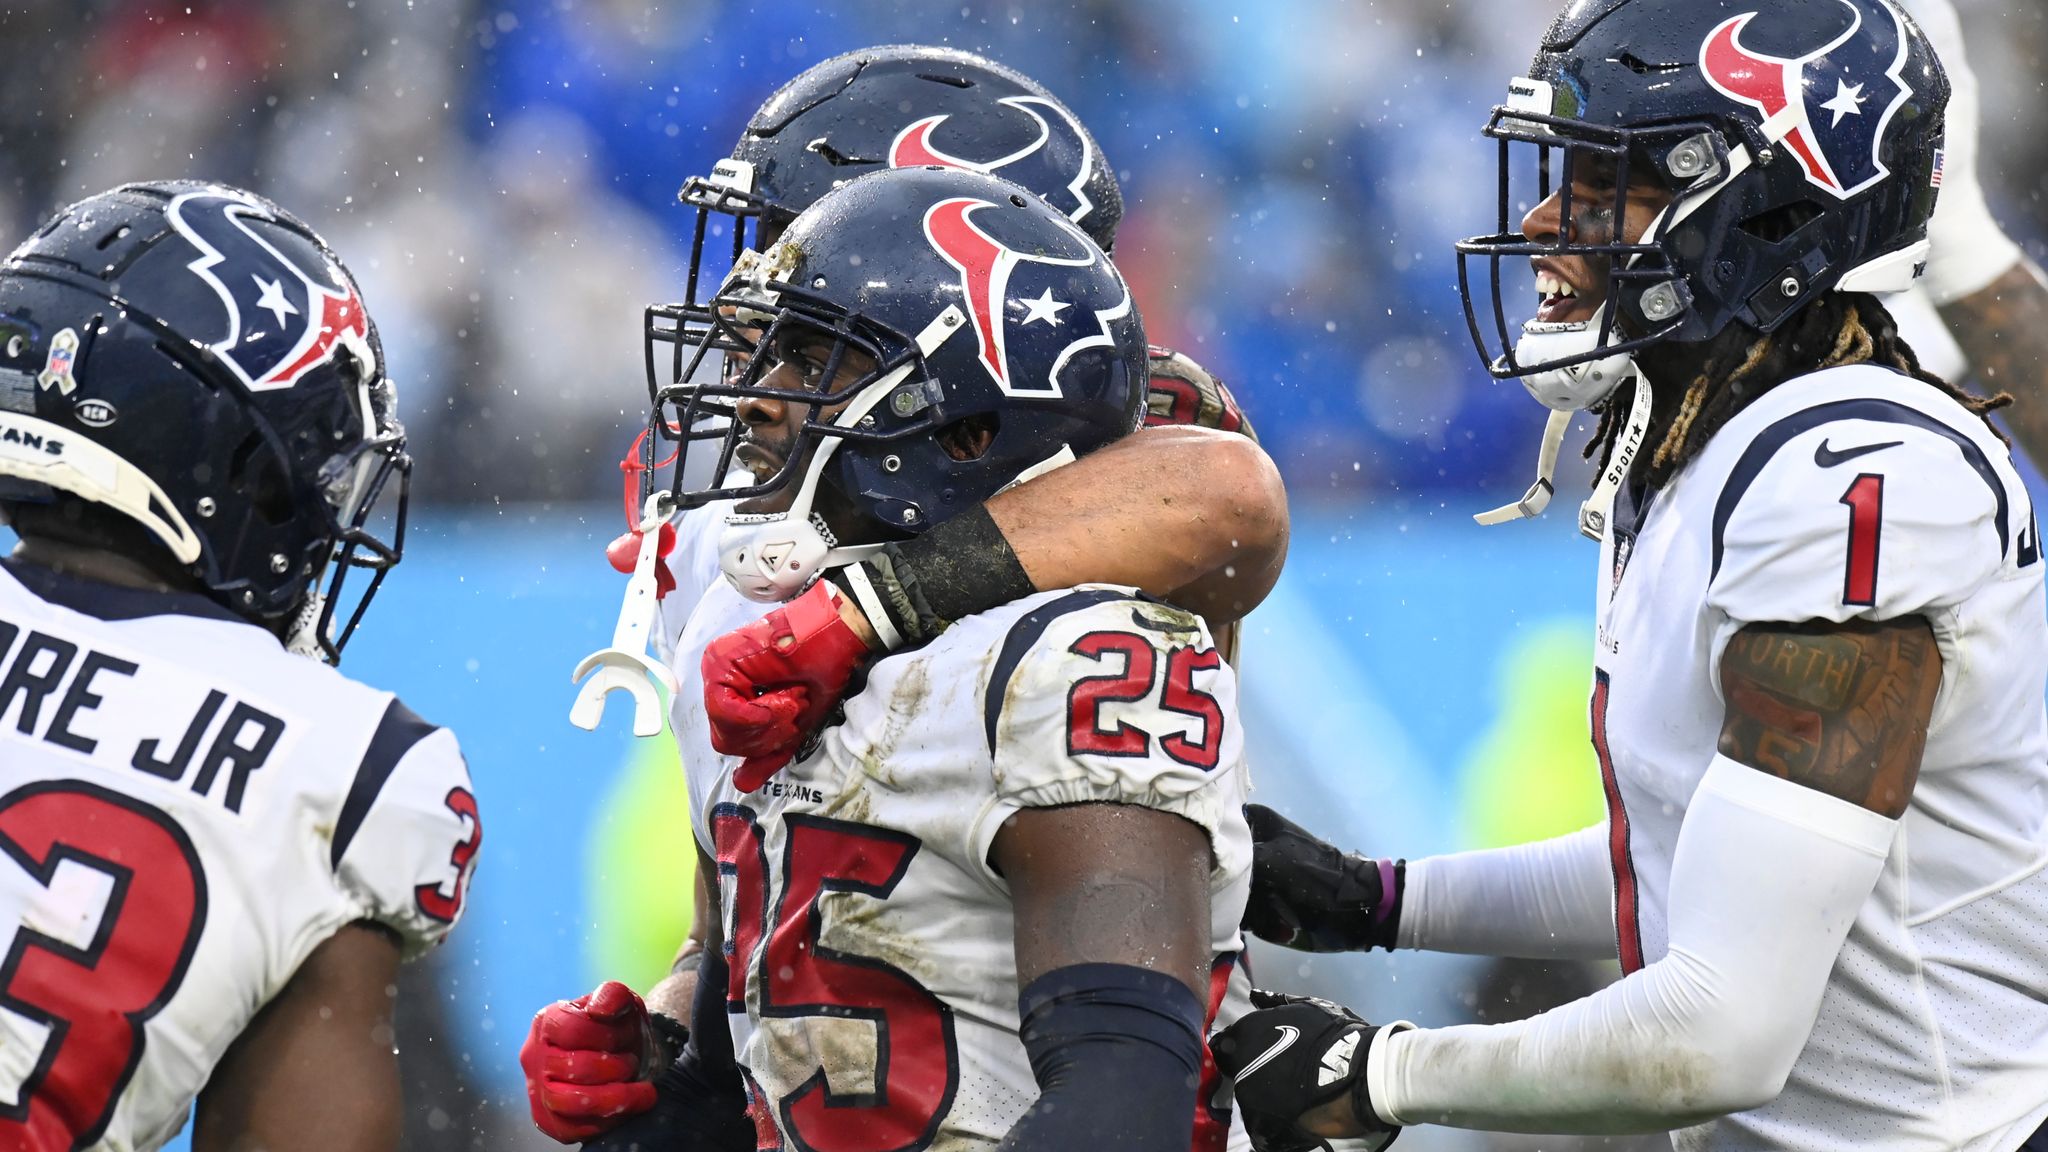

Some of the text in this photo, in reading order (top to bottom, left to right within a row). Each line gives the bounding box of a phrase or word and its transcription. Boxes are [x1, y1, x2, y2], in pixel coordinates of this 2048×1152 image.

[1838, 472, 1885, 607] 1
[131, 688, 286, 815] JR
[1065, 629, 1226, 773] 25
[762, 780, 823, 804] TEXANS
[0, 777, 209, 1152] 3
